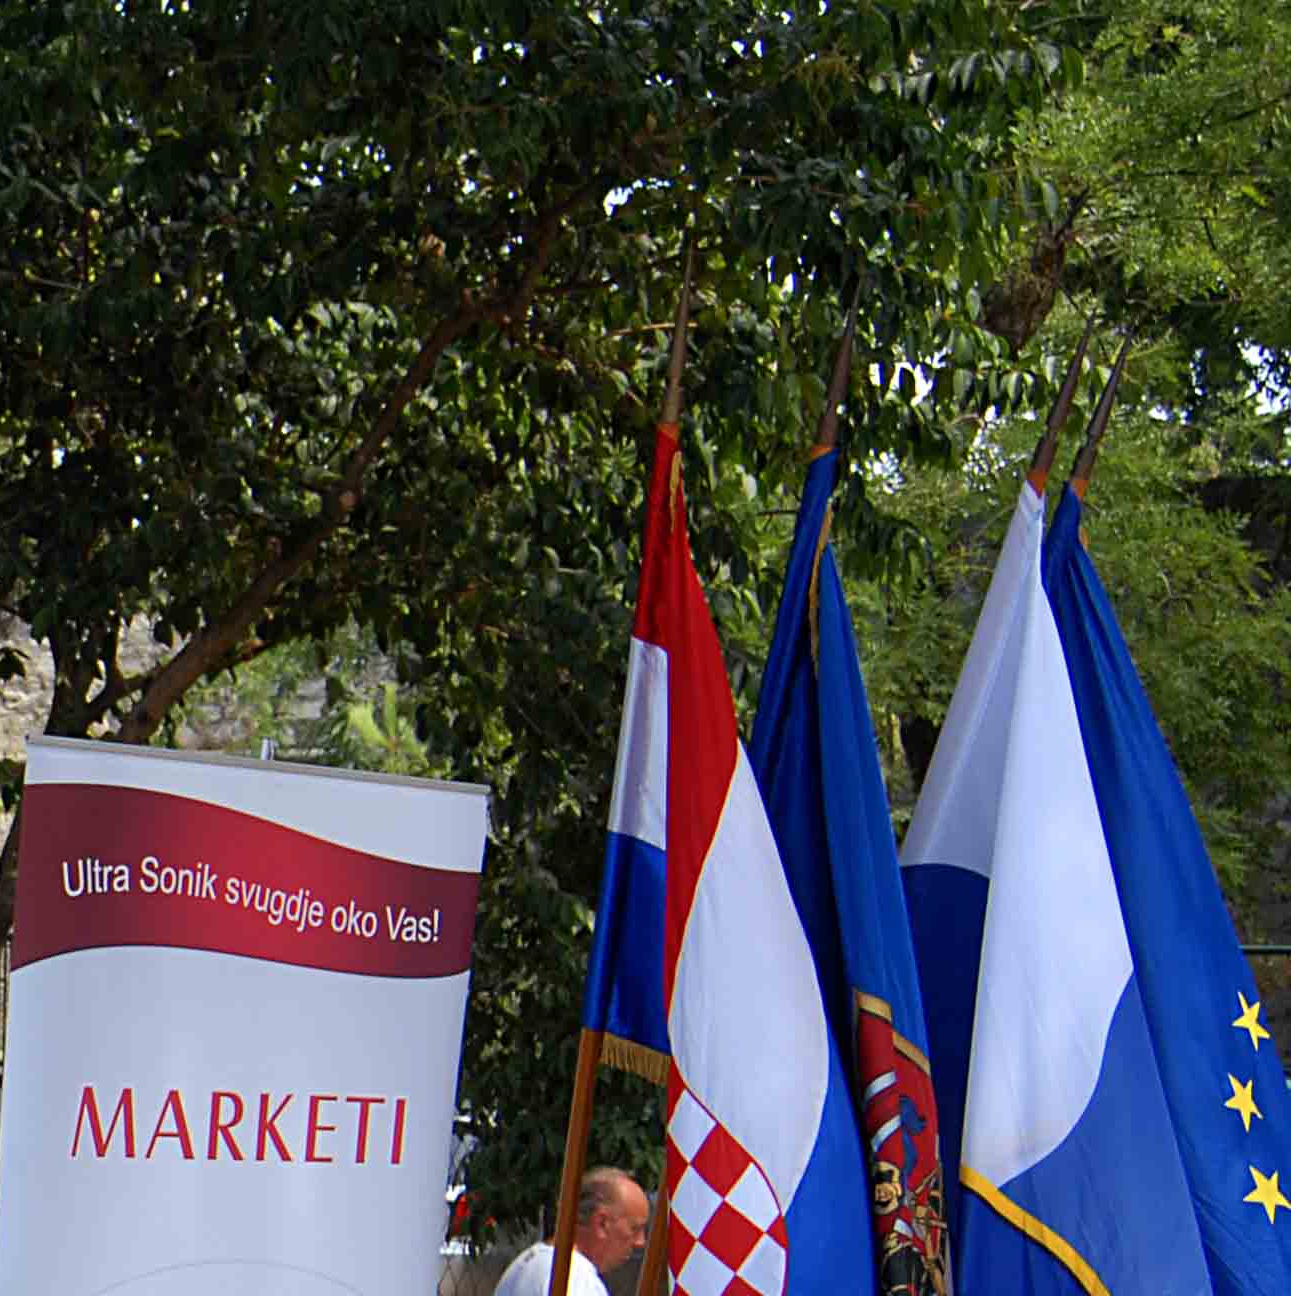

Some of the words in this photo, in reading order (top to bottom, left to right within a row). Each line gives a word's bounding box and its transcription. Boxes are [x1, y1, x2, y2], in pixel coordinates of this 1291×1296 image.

[62, 857, 130, 897] Ultra
[139, 856, 218, 900] Sonik
[225, 876, 324, 932] svugdje
[331, 900, 377, 938] oko
[386, 905, 441, 942] Vas!
[71, 1087, 407, 1165] MARKETI
